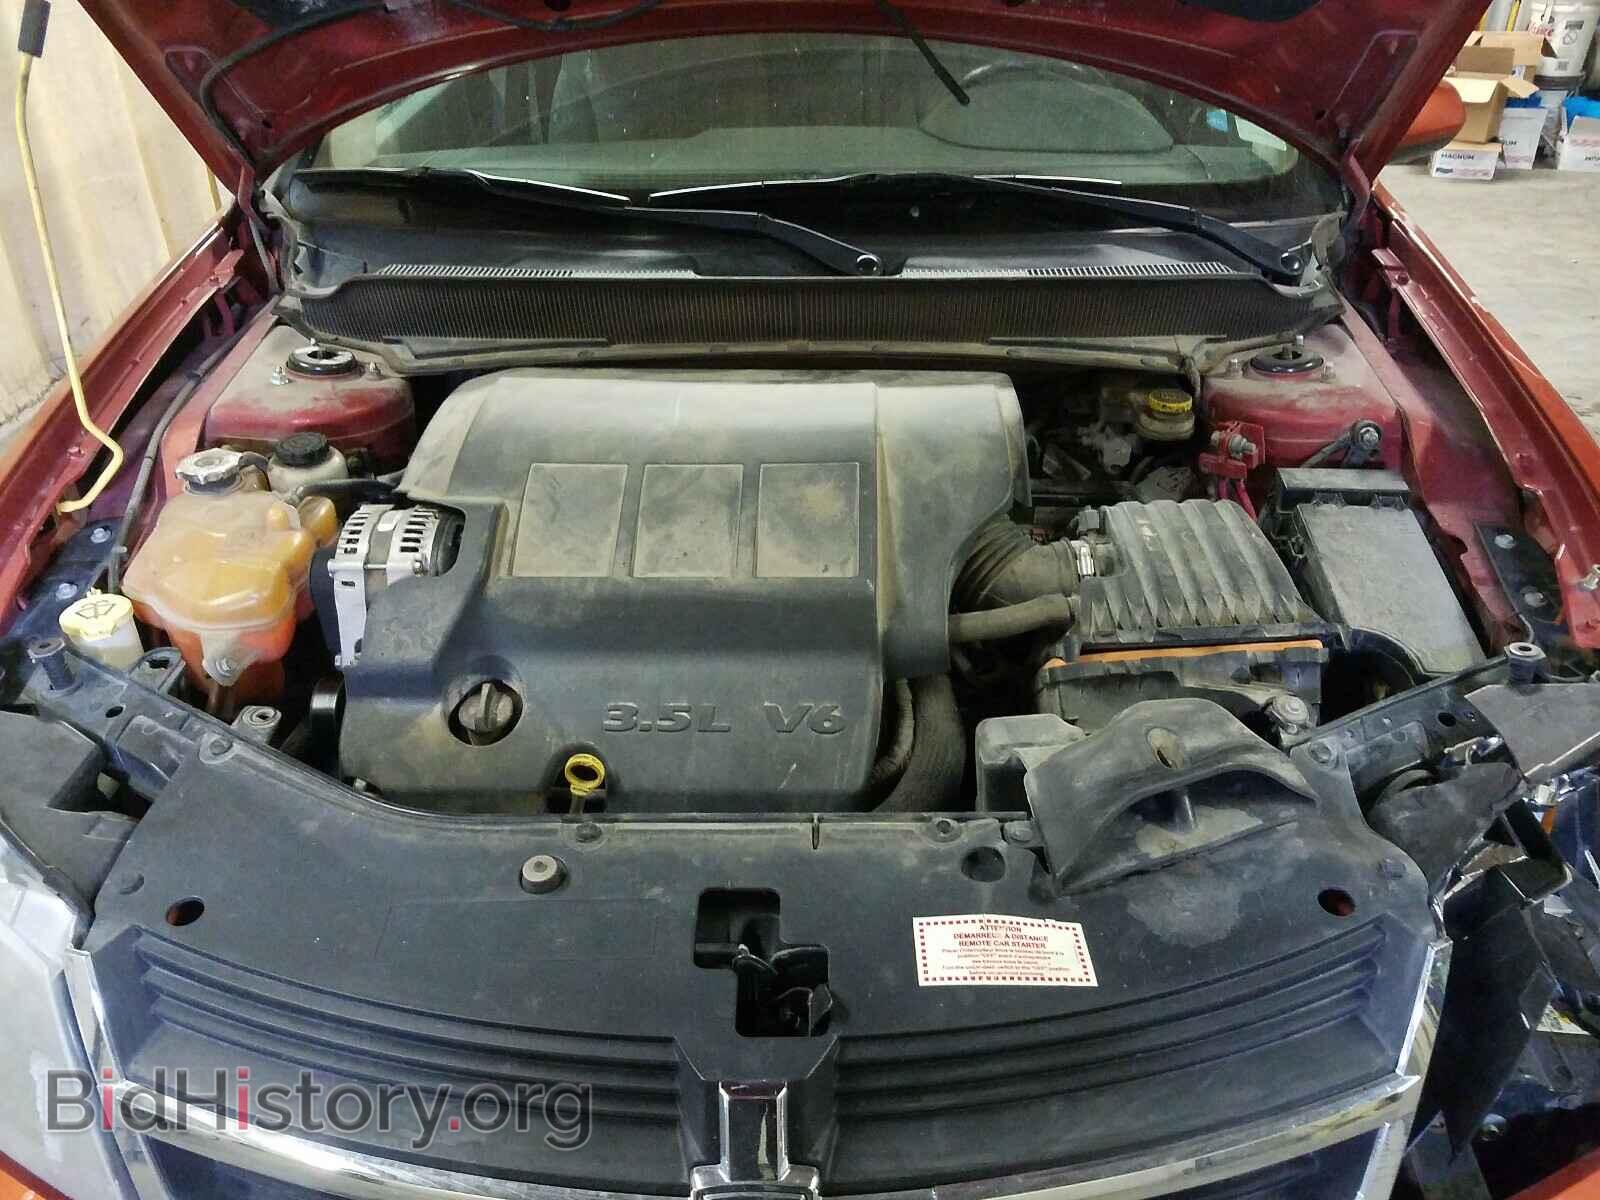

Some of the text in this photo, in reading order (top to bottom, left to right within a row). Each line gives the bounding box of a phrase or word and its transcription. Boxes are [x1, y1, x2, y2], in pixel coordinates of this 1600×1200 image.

[603, 701, 847, 734] 3.5L V6
[979, 924, 1022, 933] ATTETION
[1011, 933, 1048, 942] DISTANCE
[1011, 941, 1047, 949] STARTER
